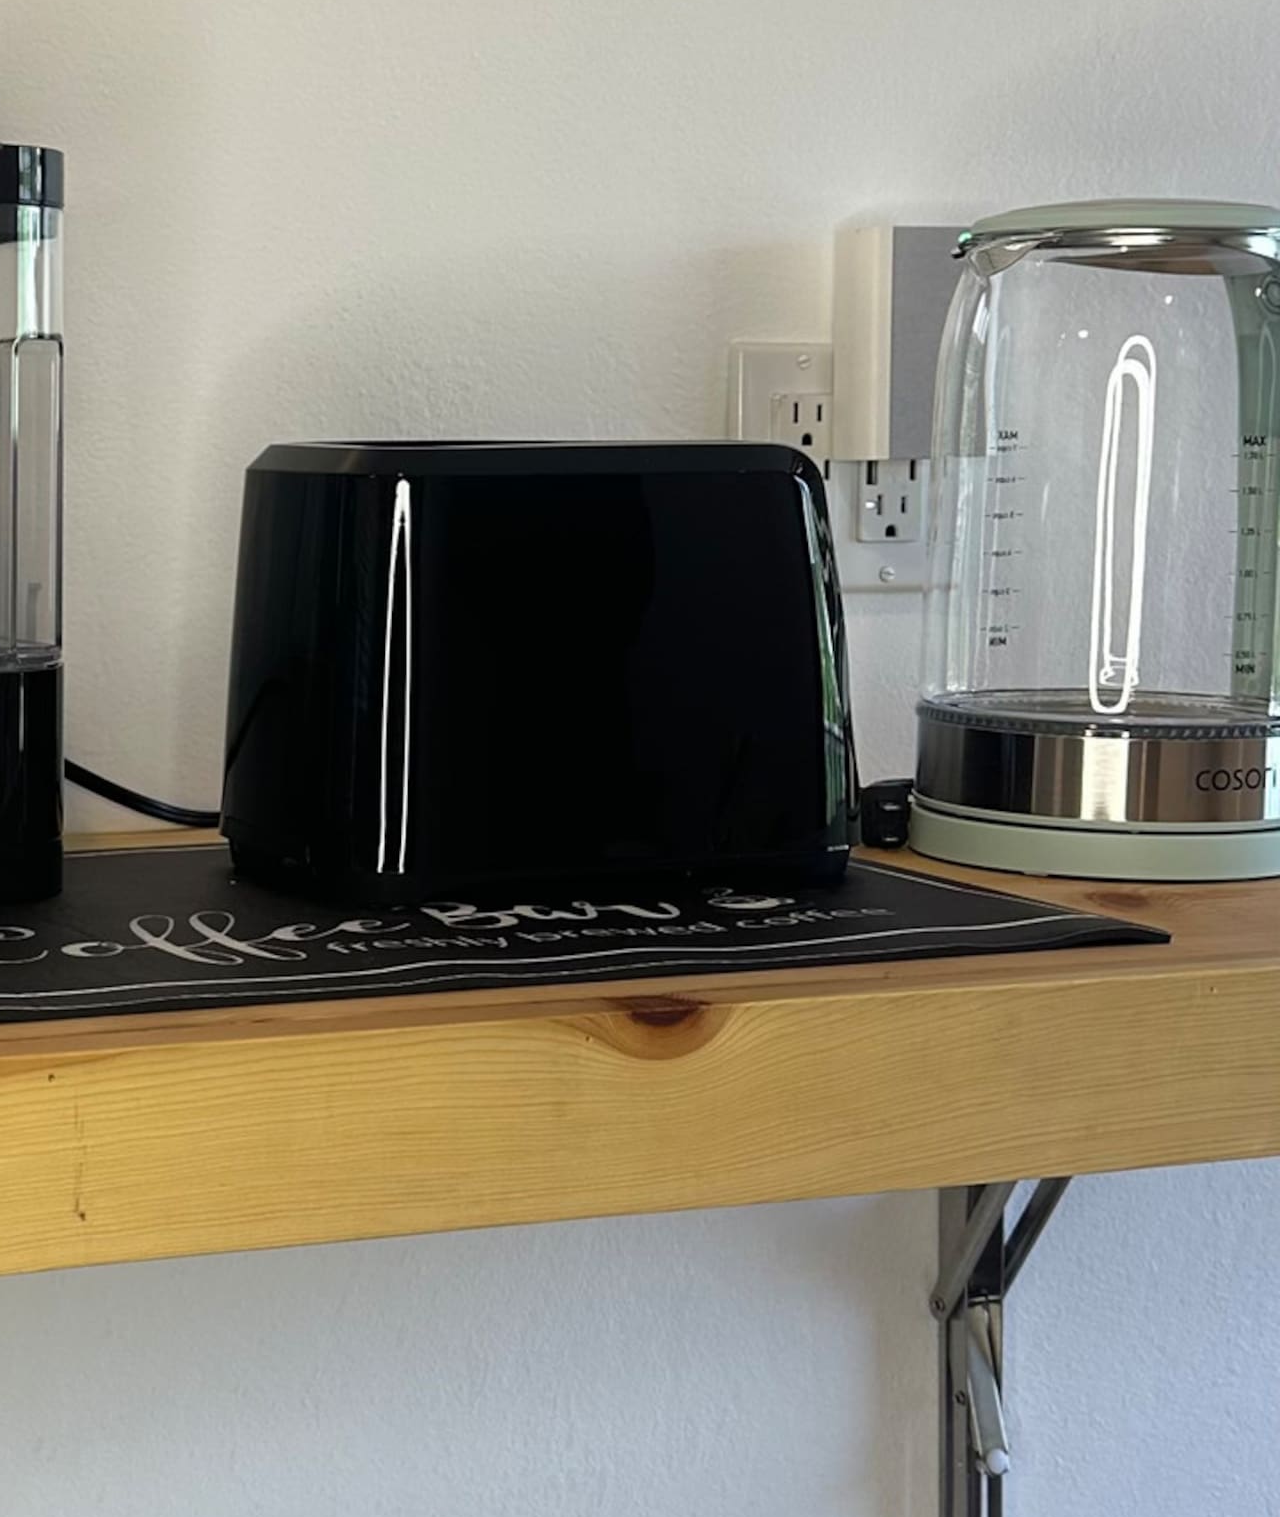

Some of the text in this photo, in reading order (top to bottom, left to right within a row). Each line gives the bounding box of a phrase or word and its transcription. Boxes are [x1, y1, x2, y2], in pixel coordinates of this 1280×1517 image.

[326, 908, 896, 954] freshly brewed coffee
[420, 901, 681, 930] Bar
